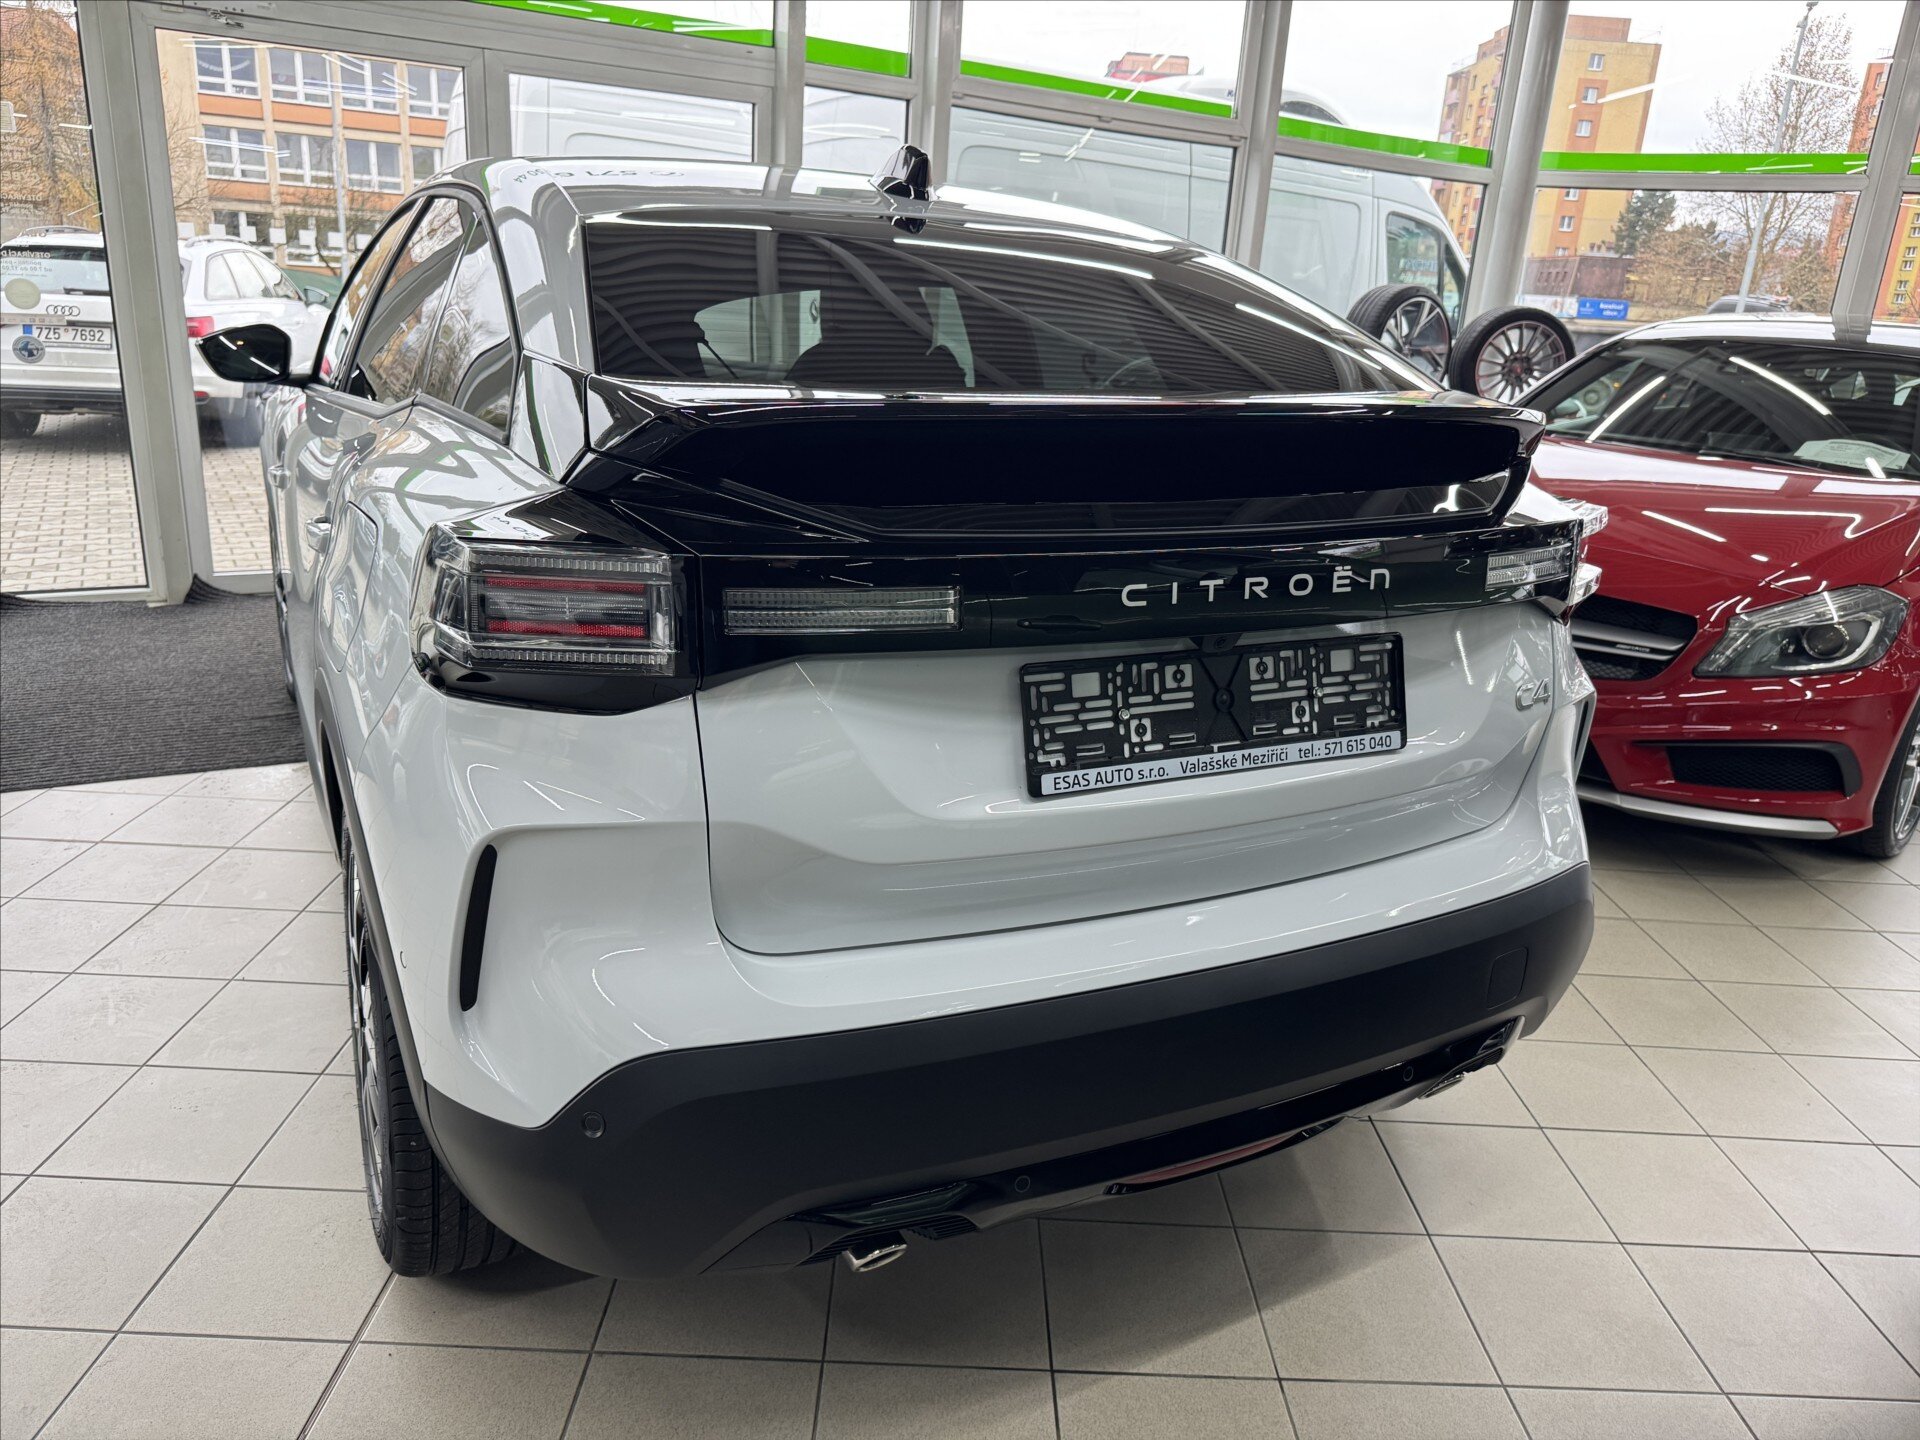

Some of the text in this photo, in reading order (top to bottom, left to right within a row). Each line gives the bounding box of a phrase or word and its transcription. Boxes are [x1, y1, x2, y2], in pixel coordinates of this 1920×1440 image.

[35, 326, 105, 342] 7Z5 7692
[1515, 678, 1551, 712] C4
[1053, 735, 1392, 791] ESAS AUTO s.r.o. Valašské Meziříčí tel.: 571 615 040
